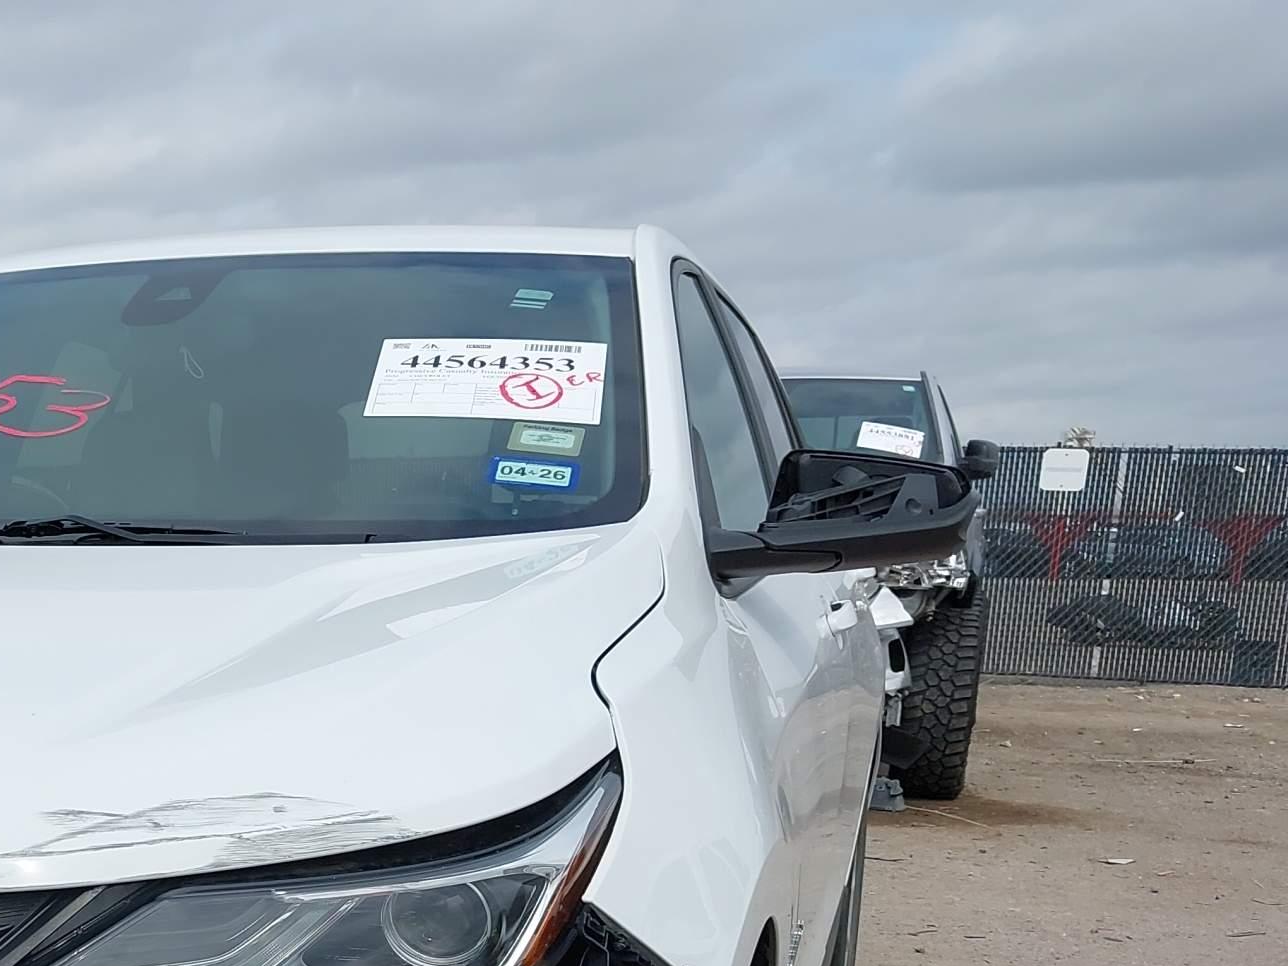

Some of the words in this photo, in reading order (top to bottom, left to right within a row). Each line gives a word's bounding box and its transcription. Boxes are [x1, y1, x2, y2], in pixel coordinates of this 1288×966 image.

[400, 355, 575, 373] 44564353
[500, 465, 527, 477] 04
[539, 468, 566, 480] 26
